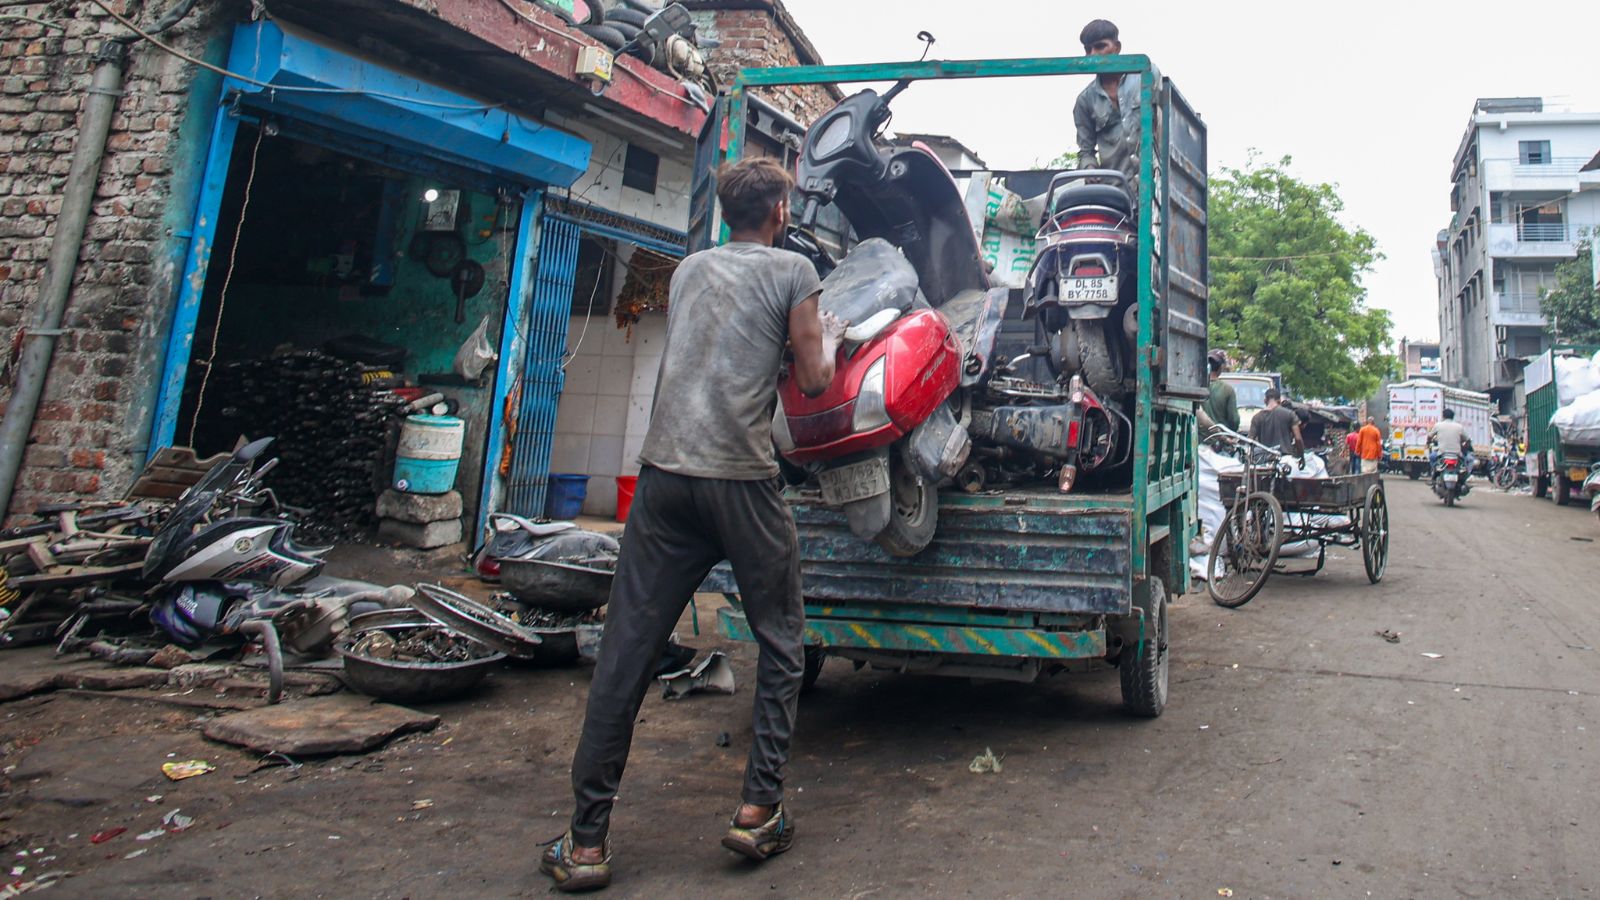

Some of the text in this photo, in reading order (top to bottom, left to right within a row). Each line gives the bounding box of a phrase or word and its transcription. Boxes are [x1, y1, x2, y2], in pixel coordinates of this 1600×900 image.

[1075, 279, 1103, 289] DL 8S
[1068, 290, 1108, 299] BY 7758
